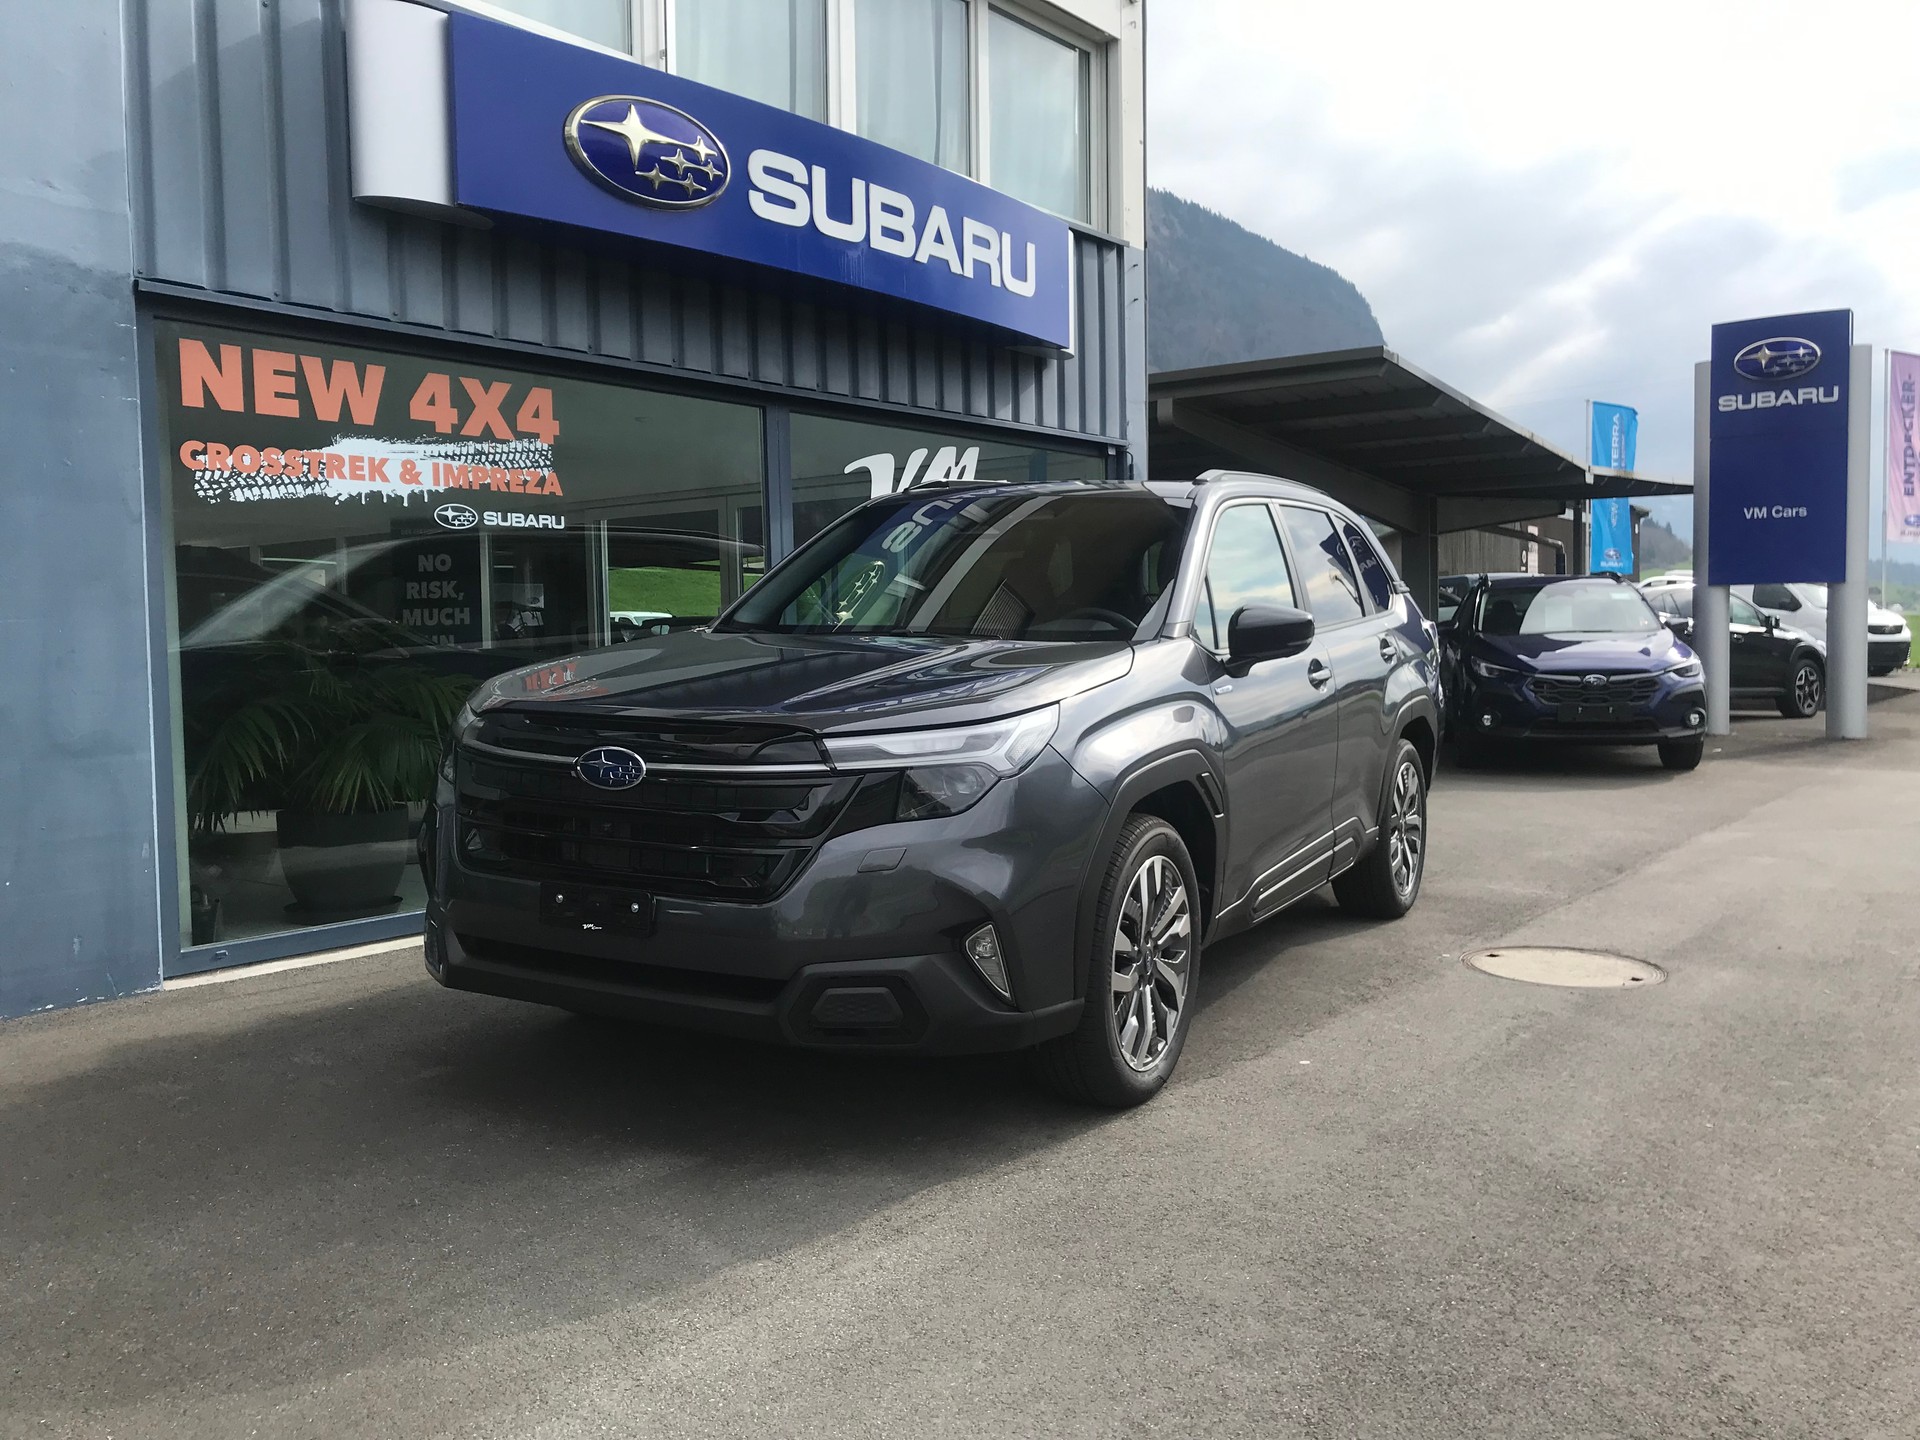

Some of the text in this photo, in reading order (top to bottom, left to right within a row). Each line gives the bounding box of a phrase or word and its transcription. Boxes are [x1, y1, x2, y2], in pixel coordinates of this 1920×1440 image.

[747, 148, 1036, 299] SUBARU
[178, 337, 560, 445] NEW 4X4
[1718, 385, 1839, 412] SUBARU
[1611, 412, 1620, 470] TERRA
[180, 440, 563, 497] CROSSTREK & IMPREZA
[483, 511, 565, 529] SUBARU
[1743, 505, 1808, 520] VM Cars
[417, 553, 452, 573] NO
[405, 581, 465, 601] RISK,
[402, 607, 471, 627] MUCH
